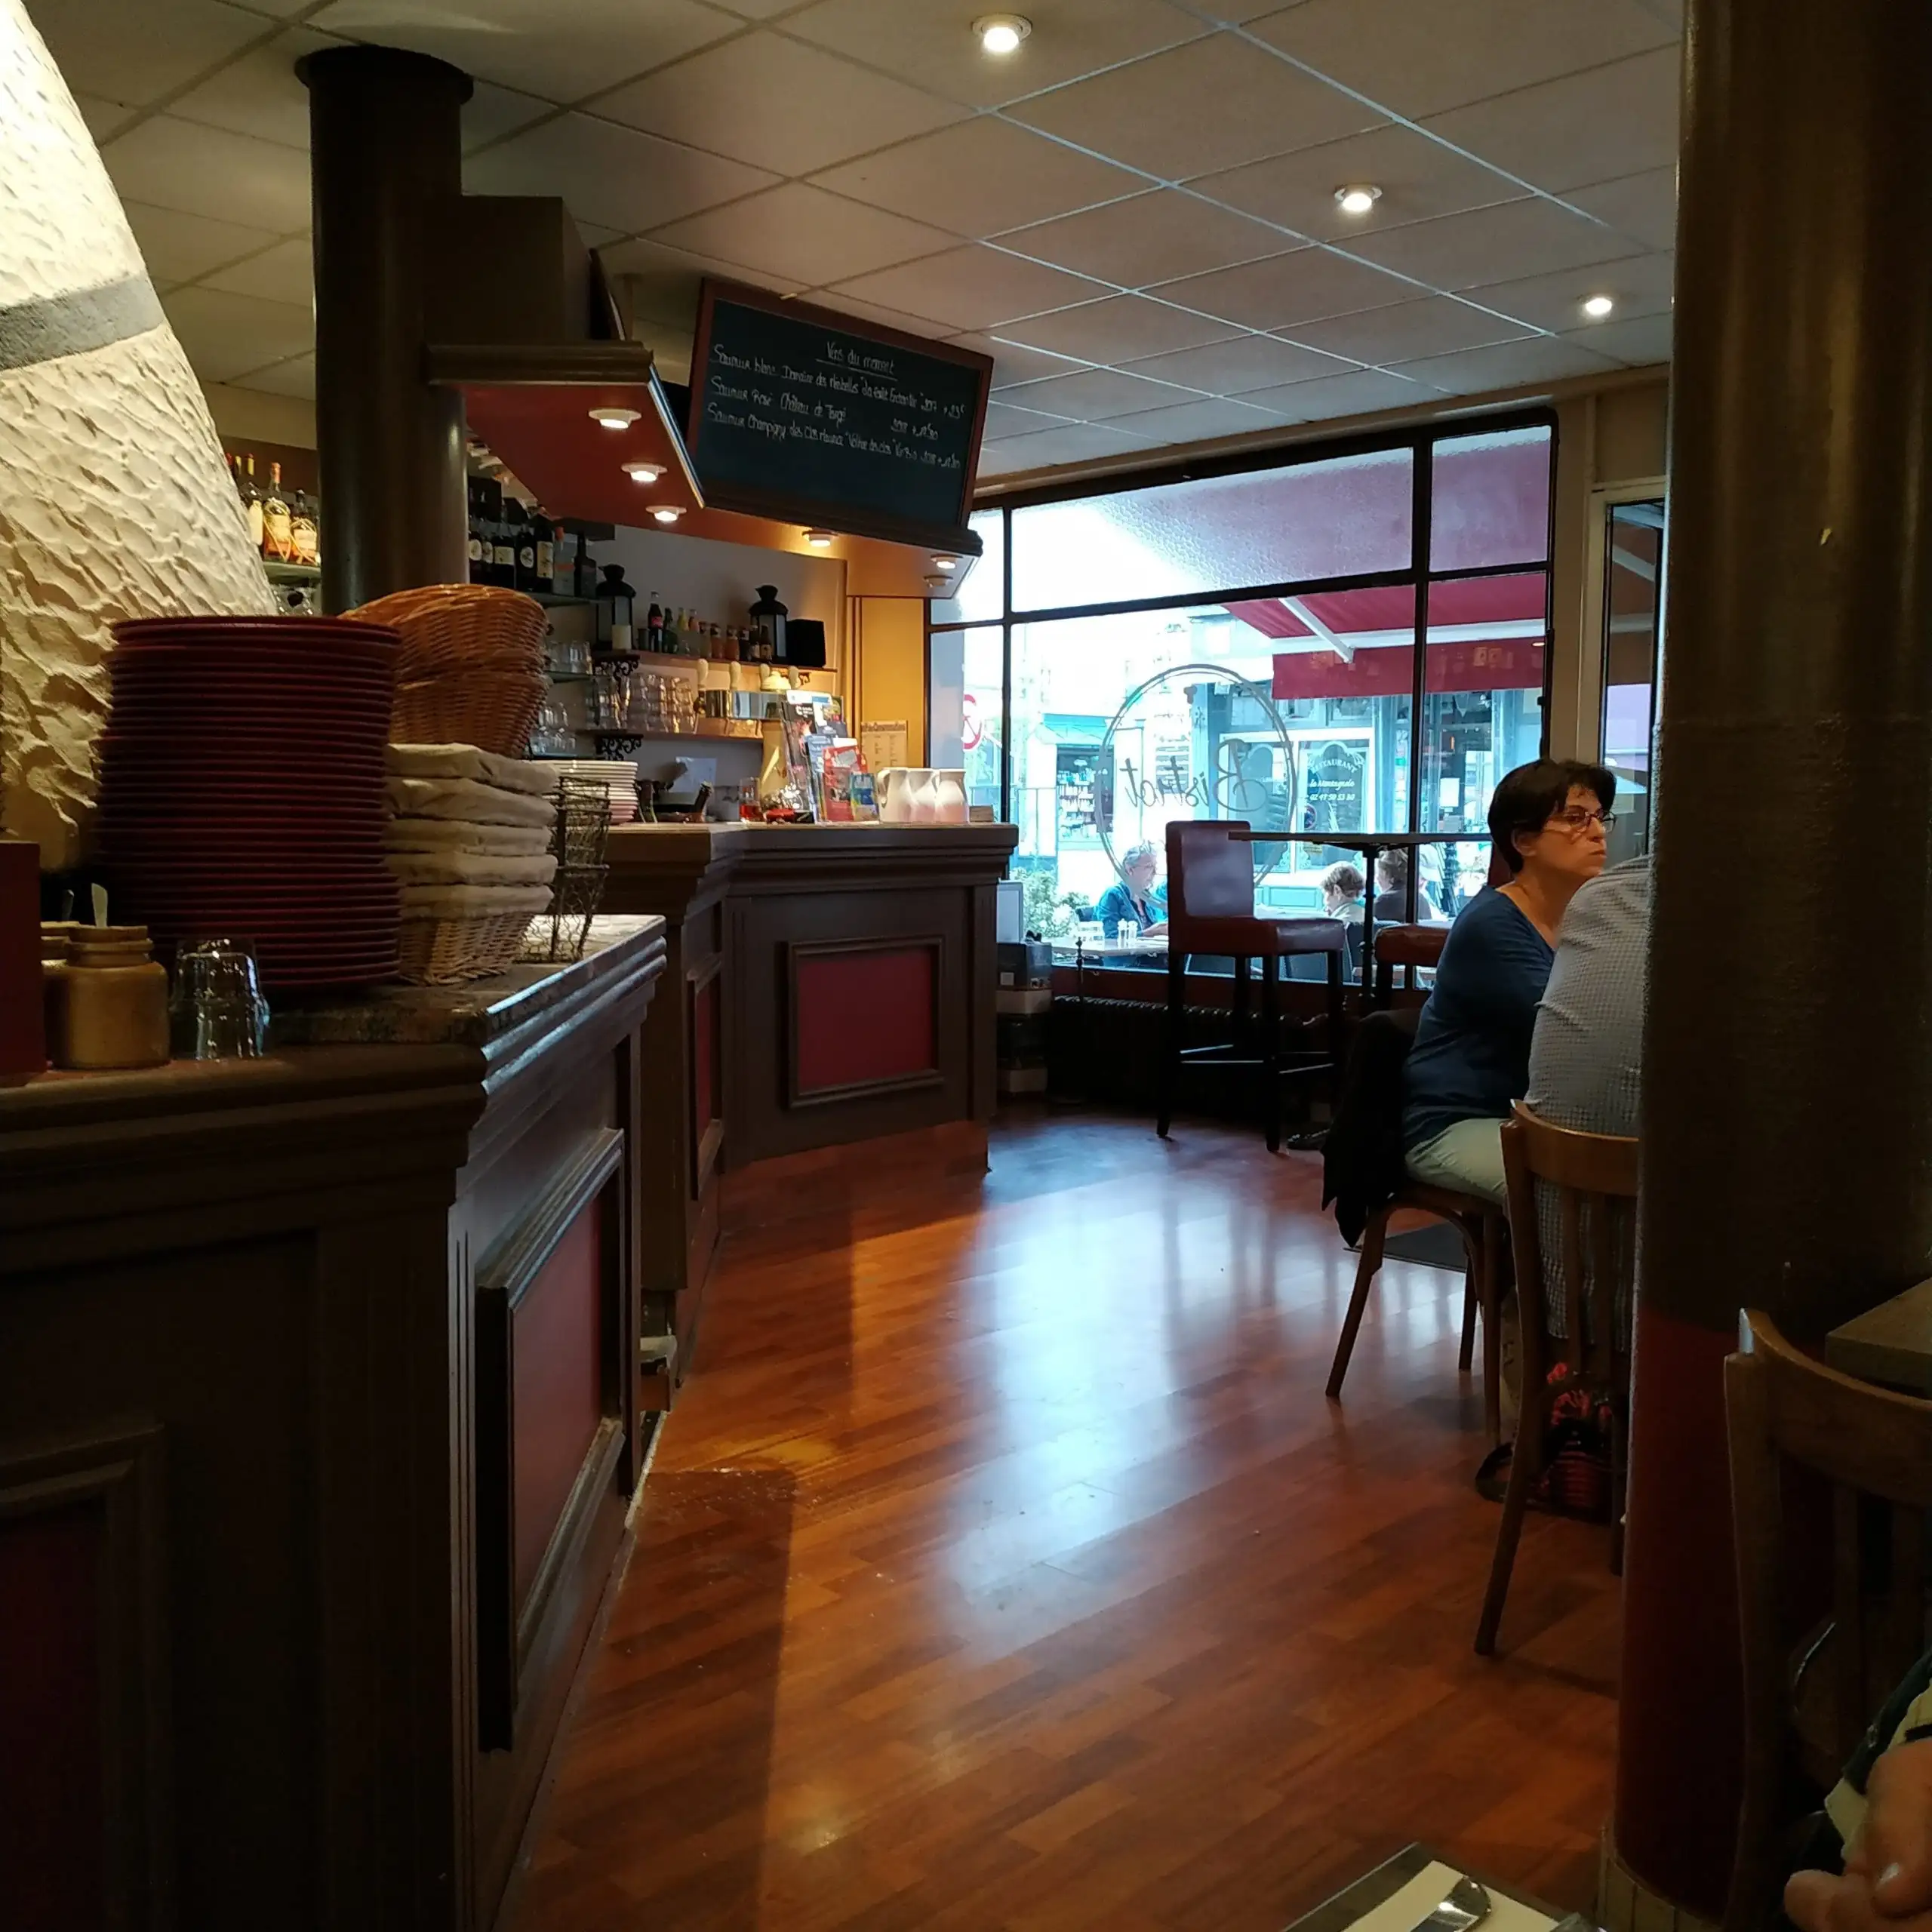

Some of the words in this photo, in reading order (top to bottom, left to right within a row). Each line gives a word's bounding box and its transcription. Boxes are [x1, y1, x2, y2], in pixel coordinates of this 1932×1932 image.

[713, 342, 752, 371] Saumur
[848, 349, 860, 366] du
[863, 356, 895, 375] moment
[710, 374, 749, 401] Saumur
[706, 401, 745, 428] Saumur
